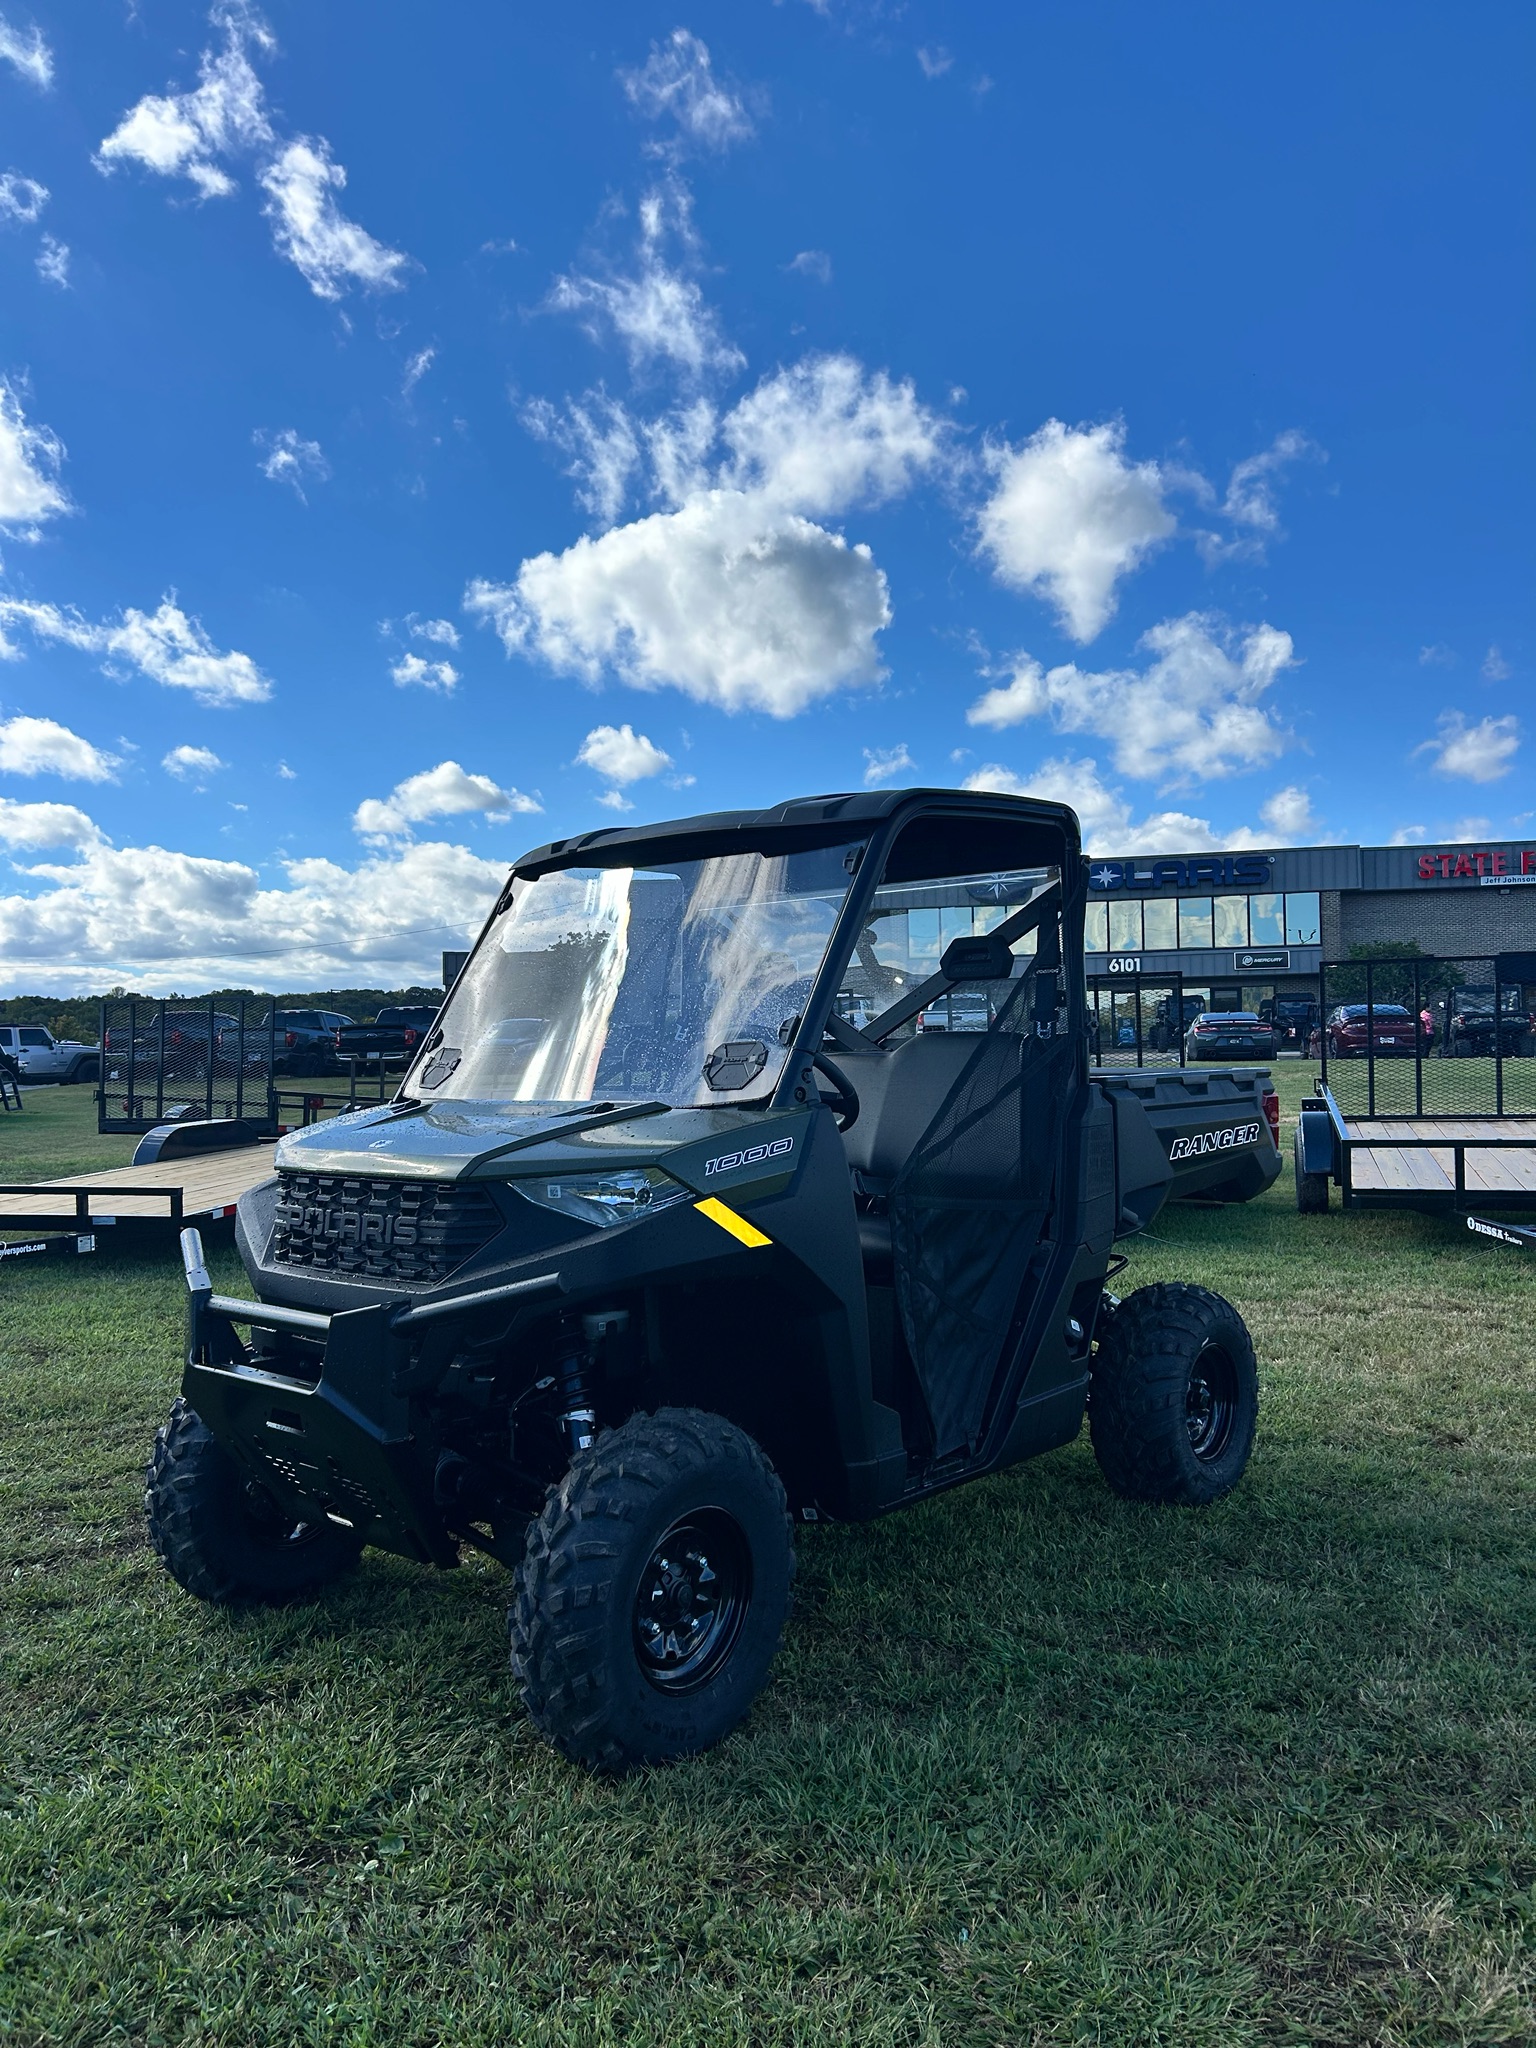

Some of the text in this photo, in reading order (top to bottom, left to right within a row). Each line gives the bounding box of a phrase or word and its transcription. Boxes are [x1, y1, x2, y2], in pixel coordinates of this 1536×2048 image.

[1088, 855, 1271, 891] OLARIS
[1418, 850, 1536, 878] STATE F
[1484, 875, 1536, 884] Jeff Johnson
[1108, 957, 1141, 973] 6101
[705, 1136, 794, 1177] 1000
[1169, 1122, 1260, 1161] RANGER
[285, 1203, 418, 1246] POLARIS
[1466, 1216, 1505, 1240] ODESSA
